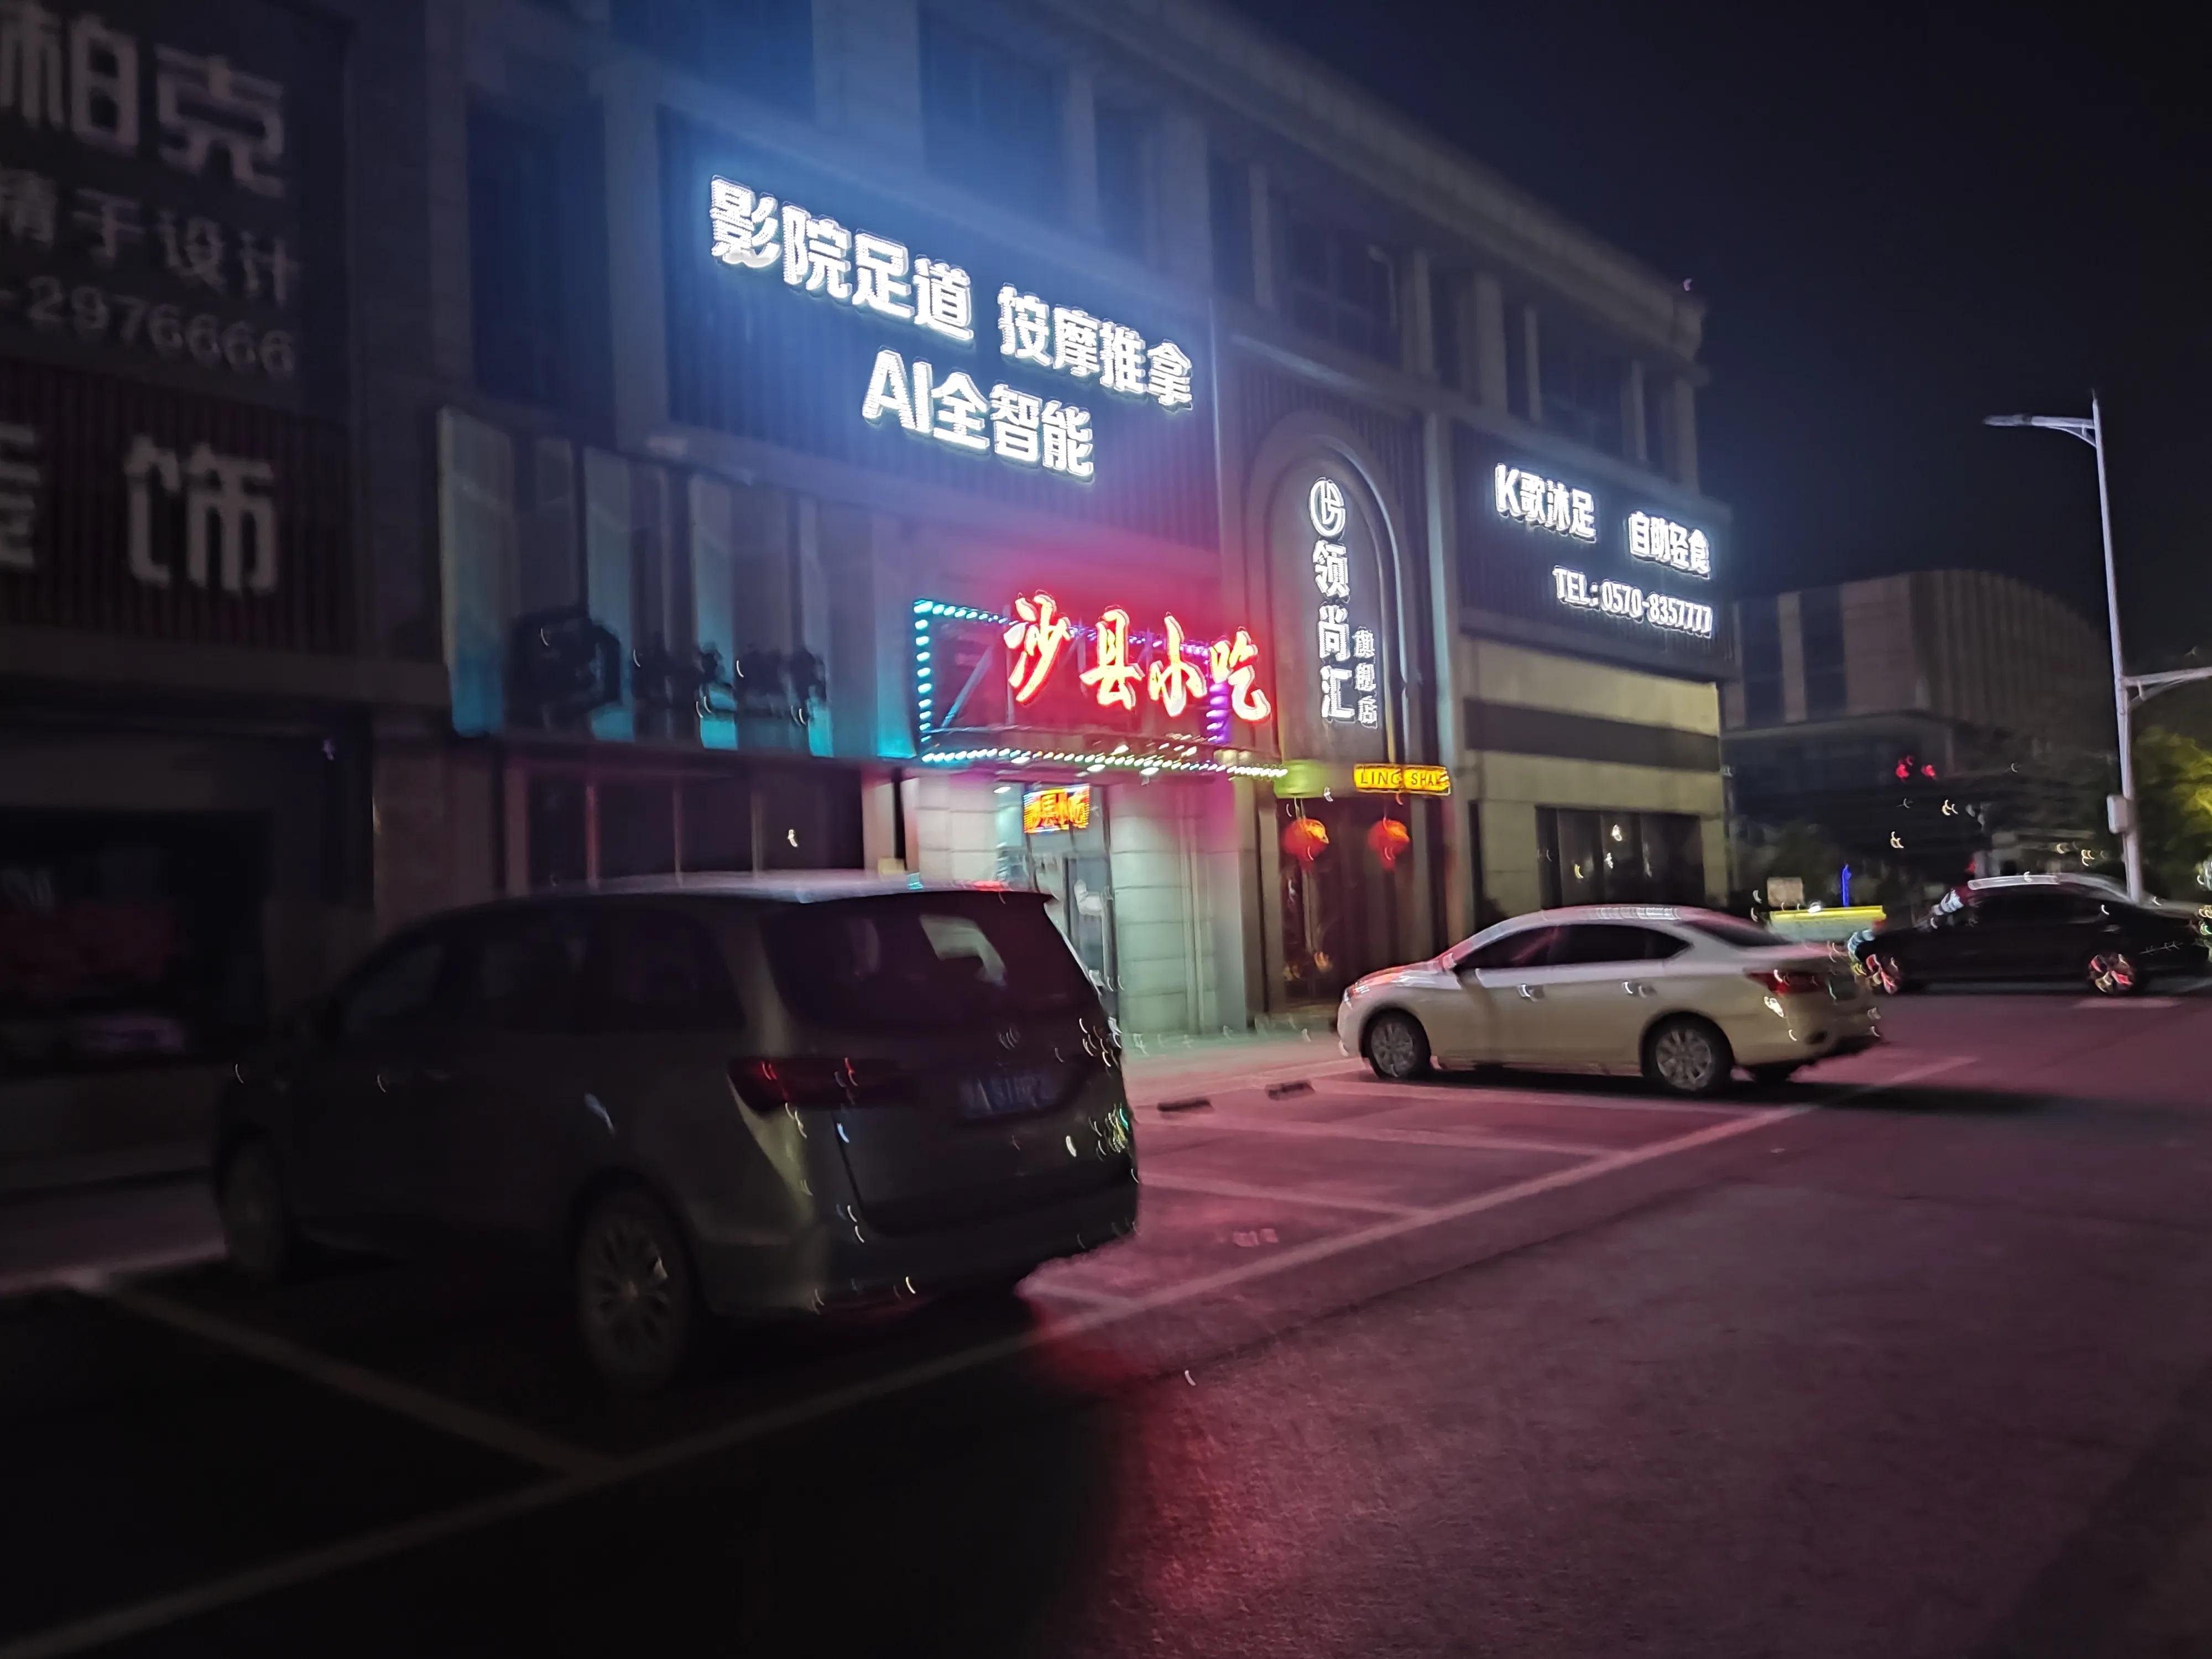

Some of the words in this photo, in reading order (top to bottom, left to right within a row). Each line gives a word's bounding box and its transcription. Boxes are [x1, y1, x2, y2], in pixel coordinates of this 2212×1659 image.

[710, 176, 974, 341] 影院足道
[998, 284, 1193, 409] 按摩推拿
[862, 347, 1094, 480] AI全智能
[1003, 589, 1271, 721] 沙县小吃
[1312, 540, 1355, 722] 领尚汇
